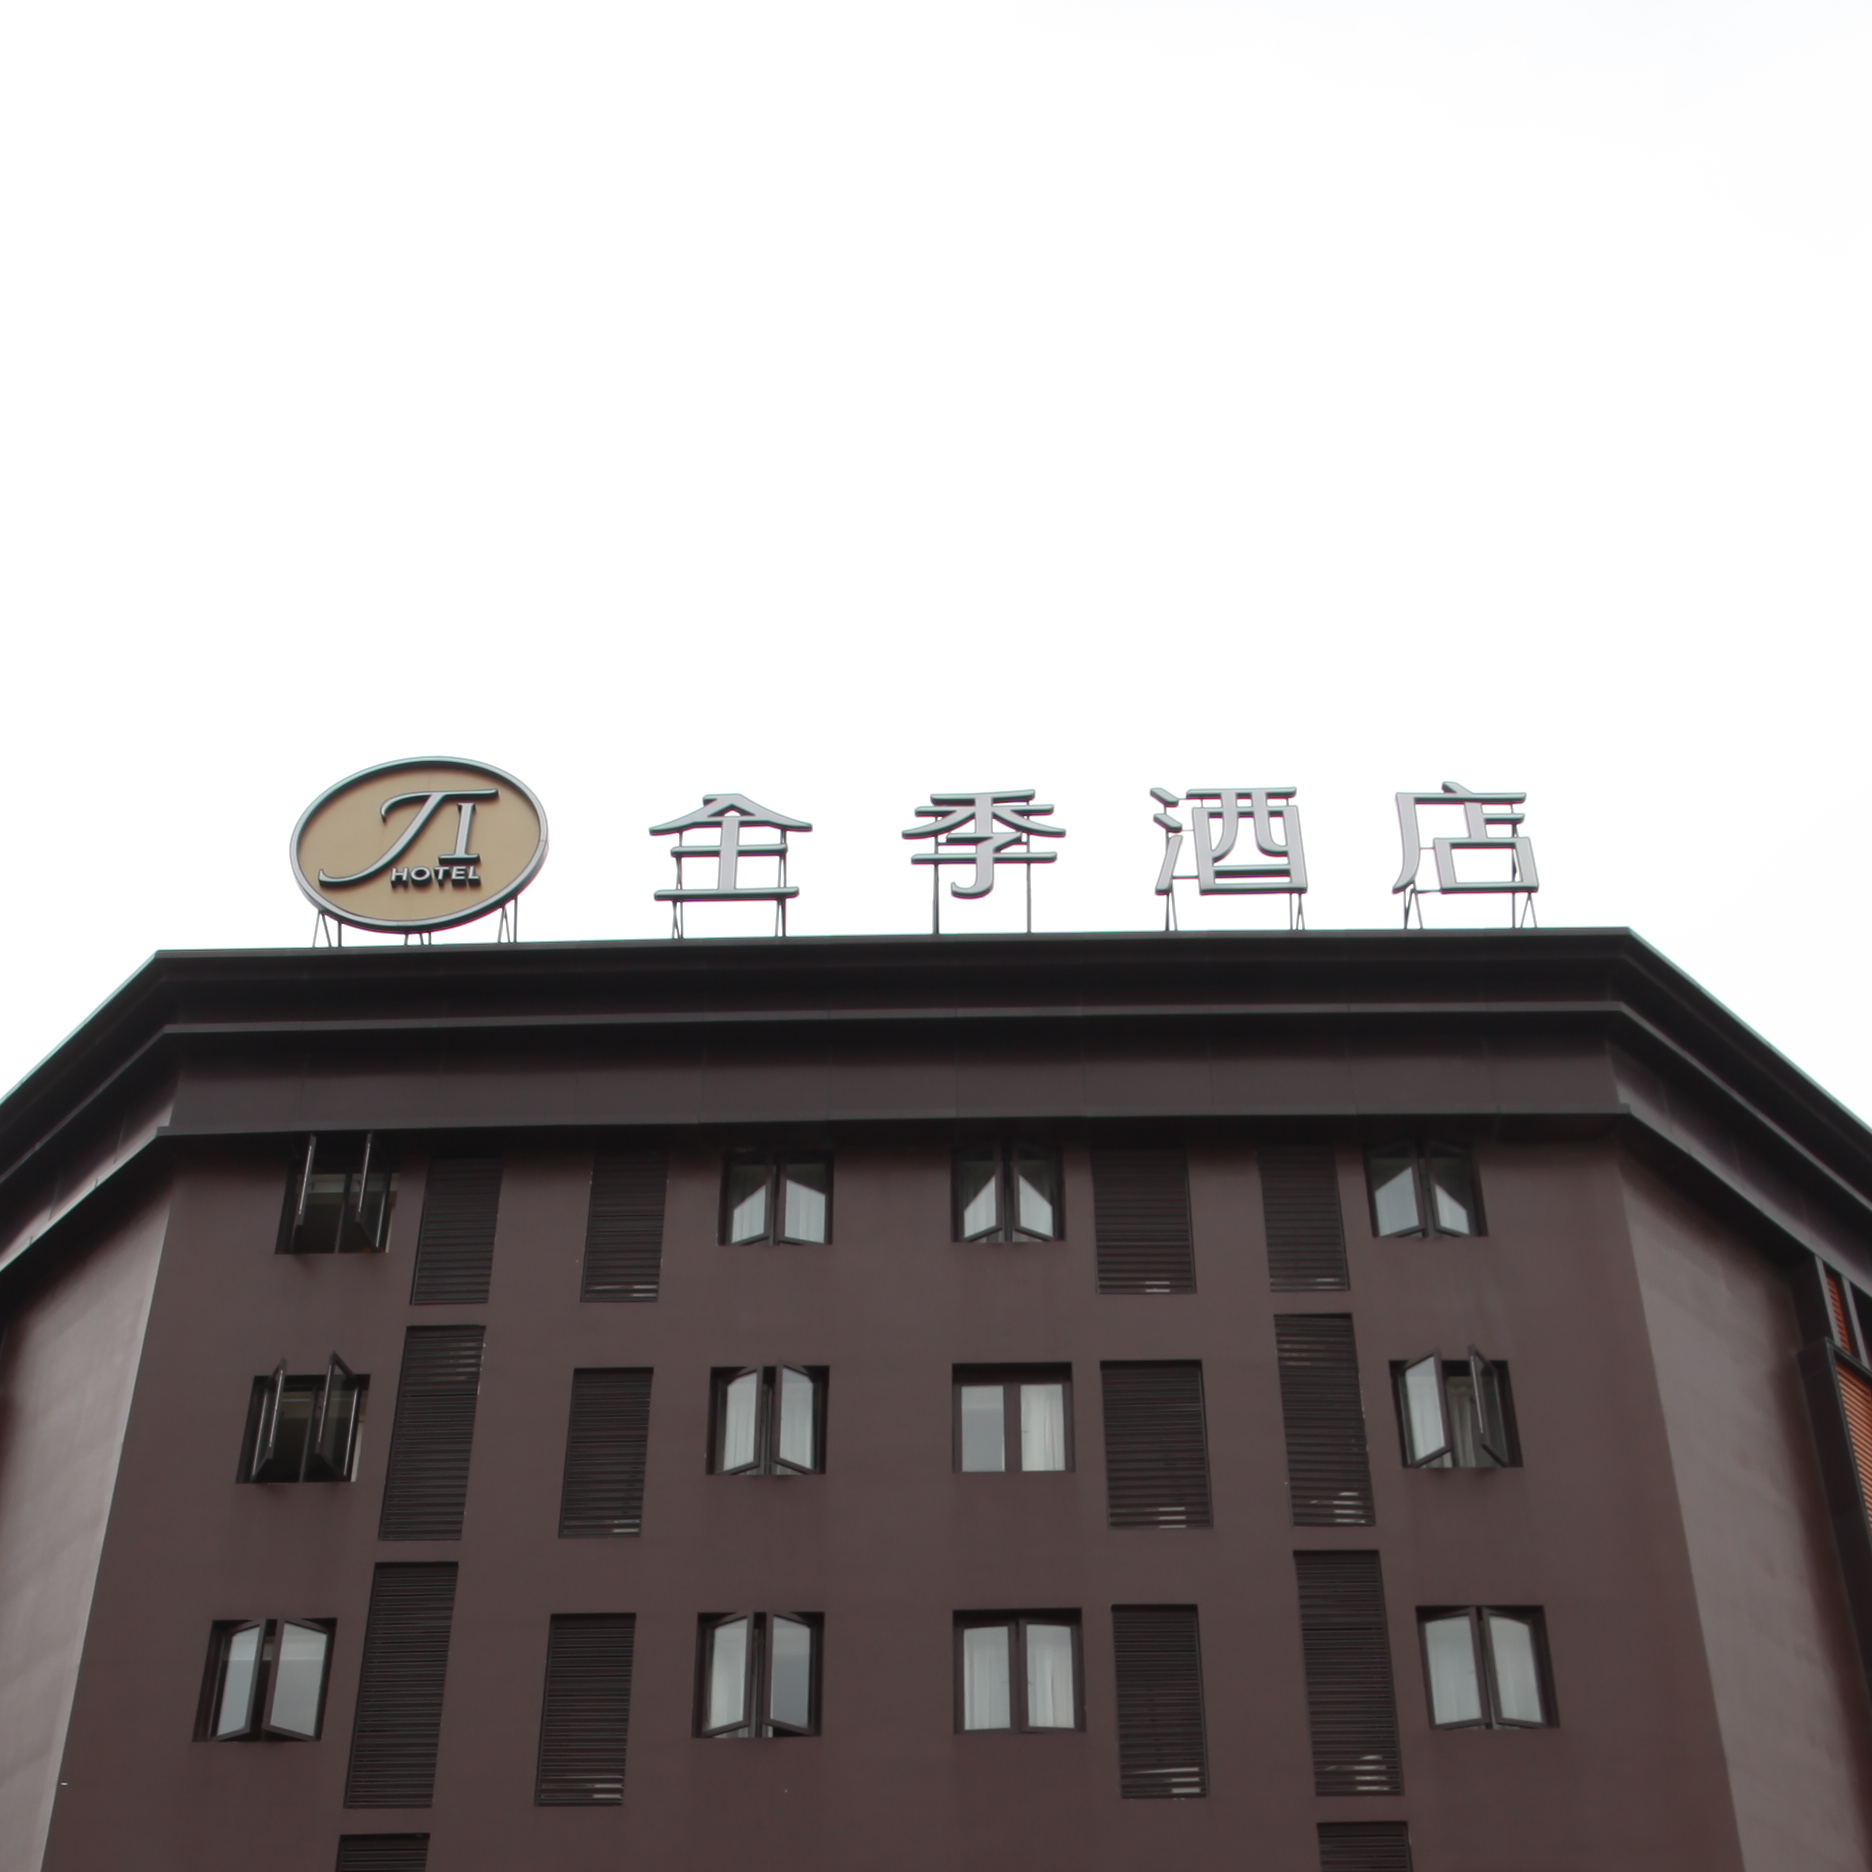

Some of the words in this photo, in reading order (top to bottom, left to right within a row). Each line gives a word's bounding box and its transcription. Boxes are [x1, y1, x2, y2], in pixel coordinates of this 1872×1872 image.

[649, 781, 1538, 899] 全季酒店
[390, 866, 481, 888] HOTEL
